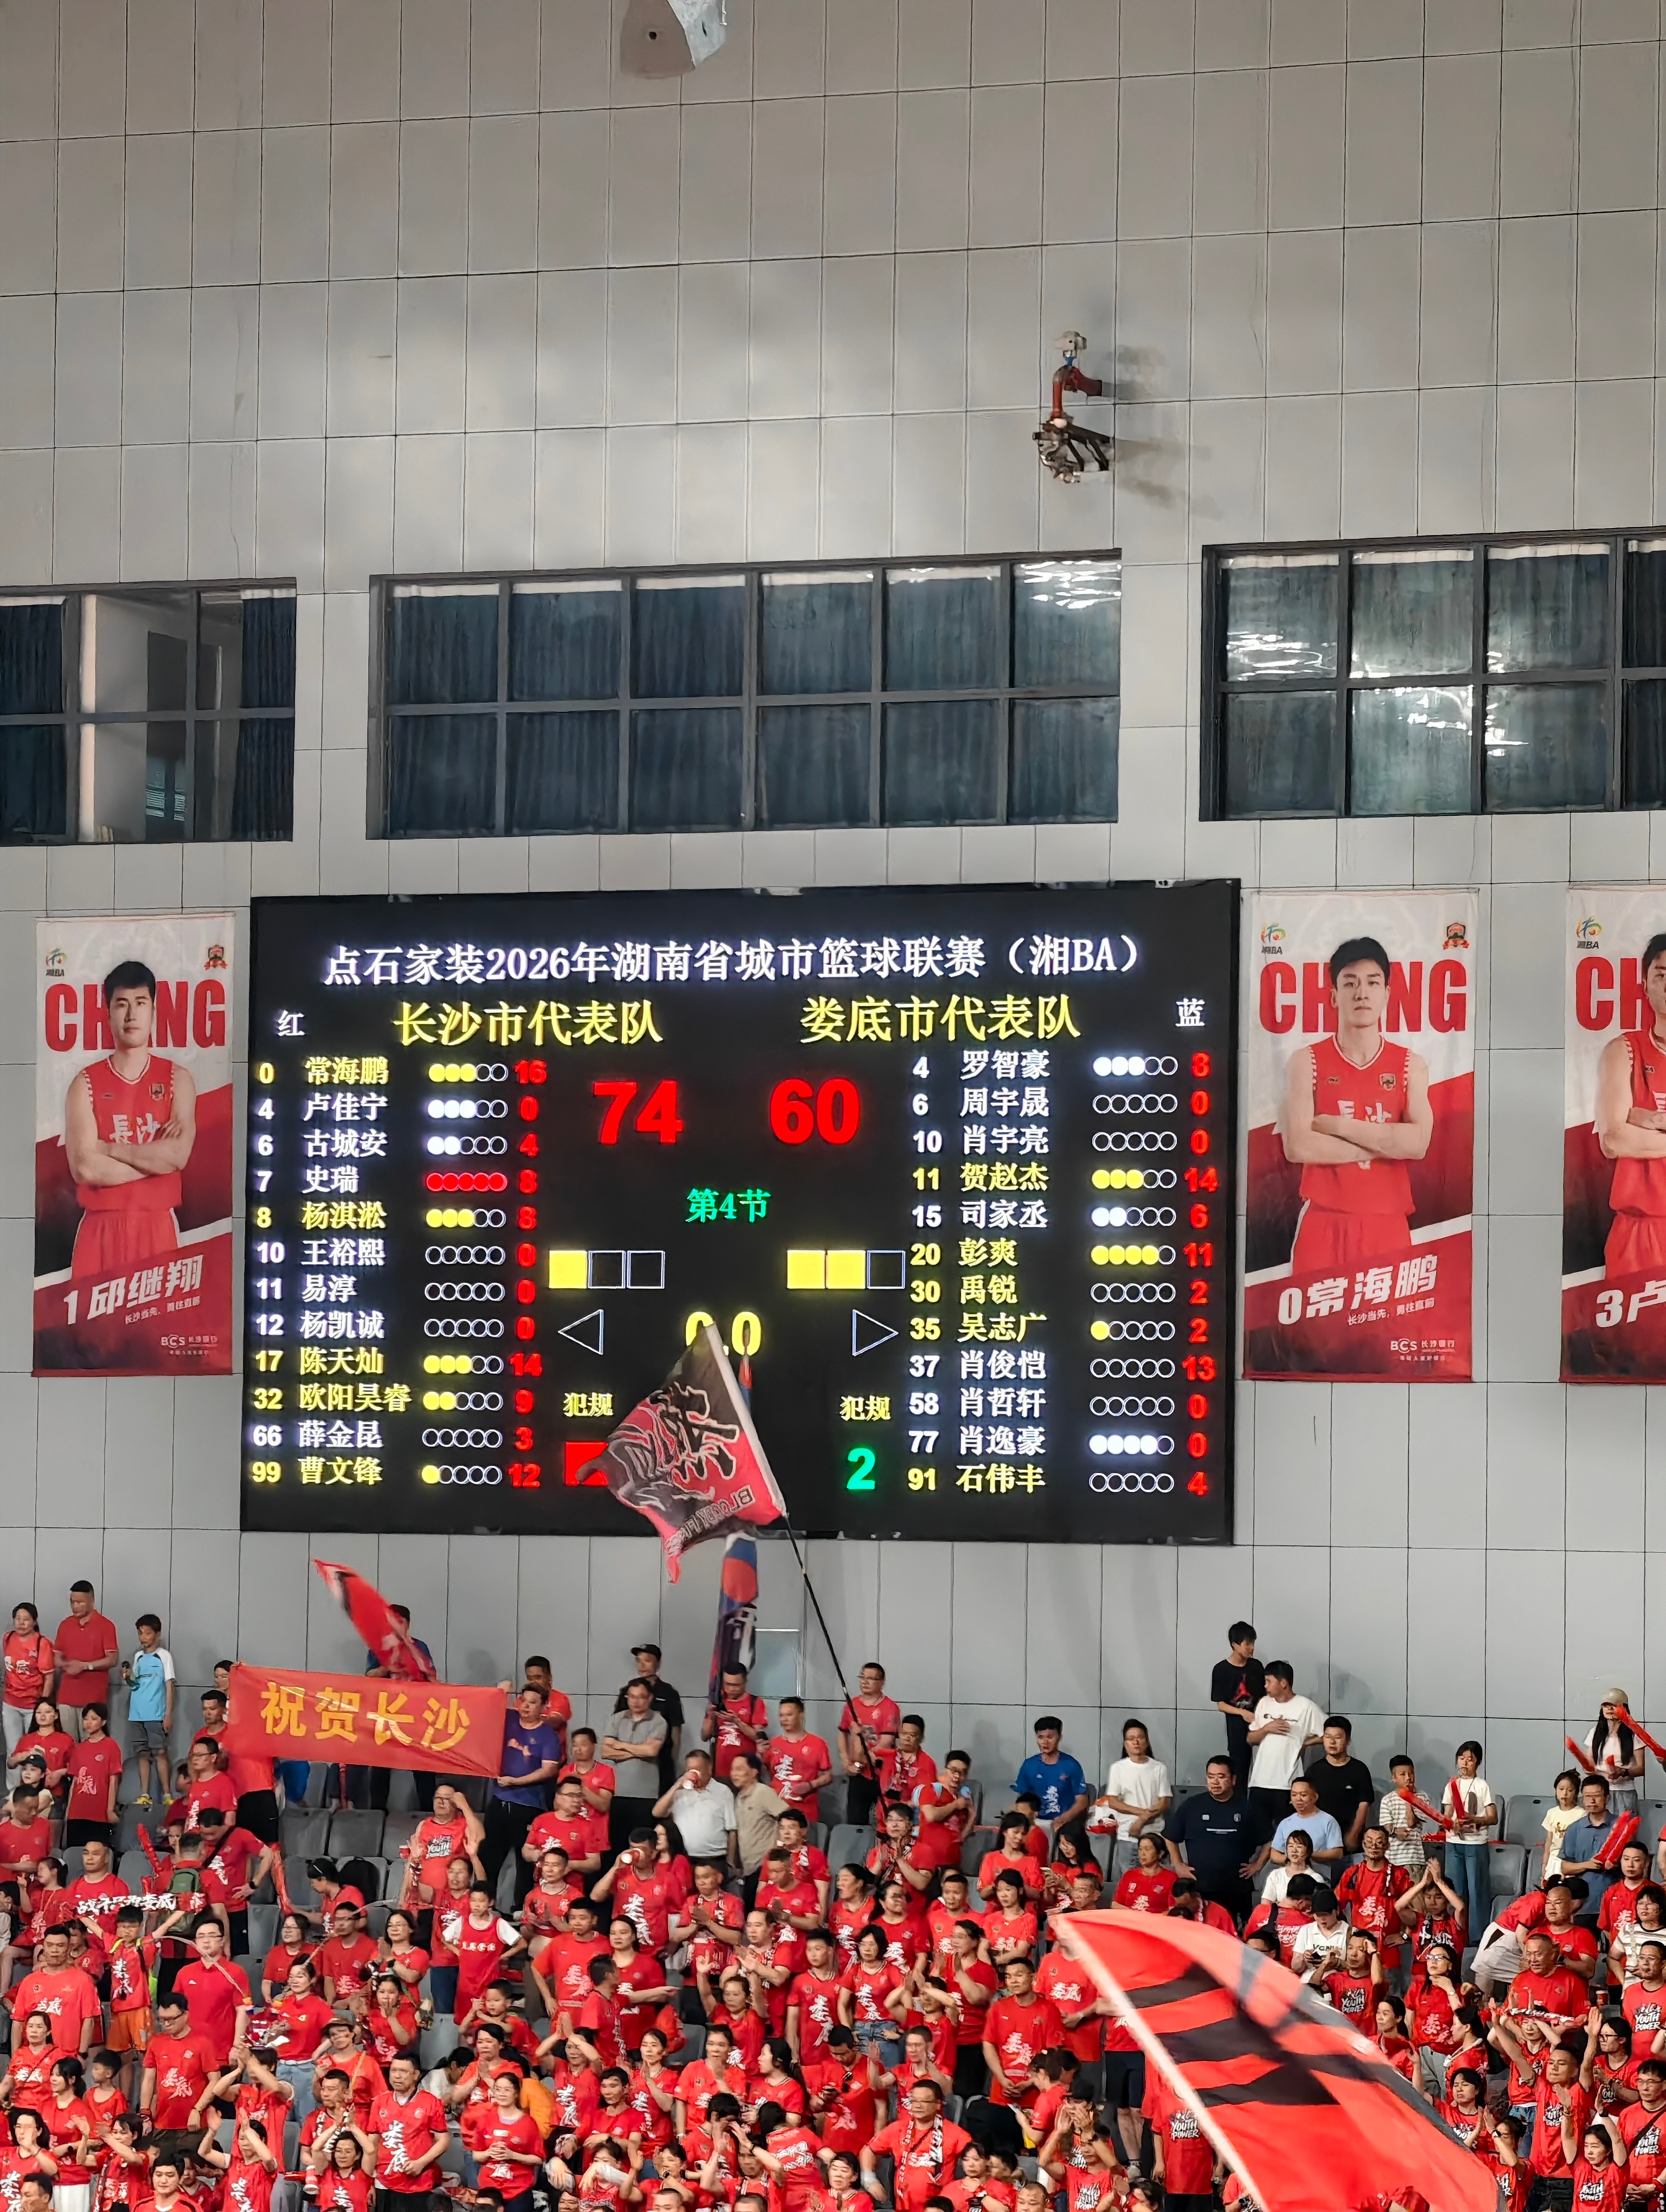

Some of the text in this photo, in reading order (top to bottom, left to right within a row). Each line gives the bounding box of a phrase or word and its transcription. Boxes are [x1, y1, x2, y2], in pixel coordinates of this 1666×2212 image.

[1259, 959, 1466, 1034] CHNG
[44, 979, 226, 1052] CHNG
[276, 1009, 305, 1037] 红
[393, 999, 663, 1046] 长沙市代表队
[800, 994, 1081, 1043] 娄底市代表队
[1175, 998, 1205, 1027] 蓝
[258, 1056, 547, 1085] 0 常海鹏 16
[912, 1049, 1210, 1080] 4 罗智豪 8
[255, 1092, 539, 1122] 4 卢佳宁 0
[593, 1079, 684, 1144] 74
[770, 1078, 860, 1144] 60
[912, 1086, 1210, 1117] 6 周宇晟 0
[254, 1128, 539, 1158] 6 古城安 4
[913, 1124, 1209, 1155] 10 肖宇亮 0
[255, 1164, 537, 1194] 7 史瑞 8
[913, 1161, 1219, 1192] 11 贺赵杰 14
[257, 1201, 537, 1230] 8 杨淇淞 8
[685, 1188, 771, 1223] 第4节
[912, 1199, 1208, 1229] 15 司家丞 6
[255, 1238, 536, 1268] 10 王裕熙 0
[910, 1237, 1213, 1268] 20 彭爽 11
[254, 1274, 536, 1304] 11 易淳 0
[910, 1275, 1208, 1304] 30 禹锐 2
[253, 1310, 535, 1340] 12 杨凯诚 0
[909, 1312, 1208, 1343] 35 吴志广 2
[161, 1335, 185, 1347] BCS
[1391, 1339, 1418, 1352] BCS
[255, 1346, 542, 1377] 17 陈天灿 14
[909, 1349, 1216, 1381] 37 肖俊恺 13
[253, 1382, 534, 1414] 32 欧阳昊睿 9
[562, 1392, 613, 1417] 犯规
[839, 1395, 891, 1422] 犯规
[909, 1387, 1208, 1419] 58 肖哲轩 0
[252, 1419, 534, 1451] 66 薛金昆 3
[908, 1425, 1208, 1458] 77 肖逸豪 0
[252, 1456, 541, 1488] 99 曹文锋 12
[847, 1448, 875, 1490] 2
[908, 1463, 1208, 1496] 91 石伟丰 4
[260, 1682, 471, 1752] 祝贺长沙
[427, 1841, 450, 1853] YOUTH
[1341, 1995, 1364, 2007] YOUTH
[1635, 2012, 1660, 2024] YOUTH
[1635, 2022, 1661, 2033] POWER
[161, 2067, 193, 2100] 娄底
[1172, 2119, 1197, 2131] YOUTH
[1172, 2129, 1199, 2140] POWER
[381, 2120, 411, 2175] 娄底
[1635, 2145, 1659, 2156] POWER
